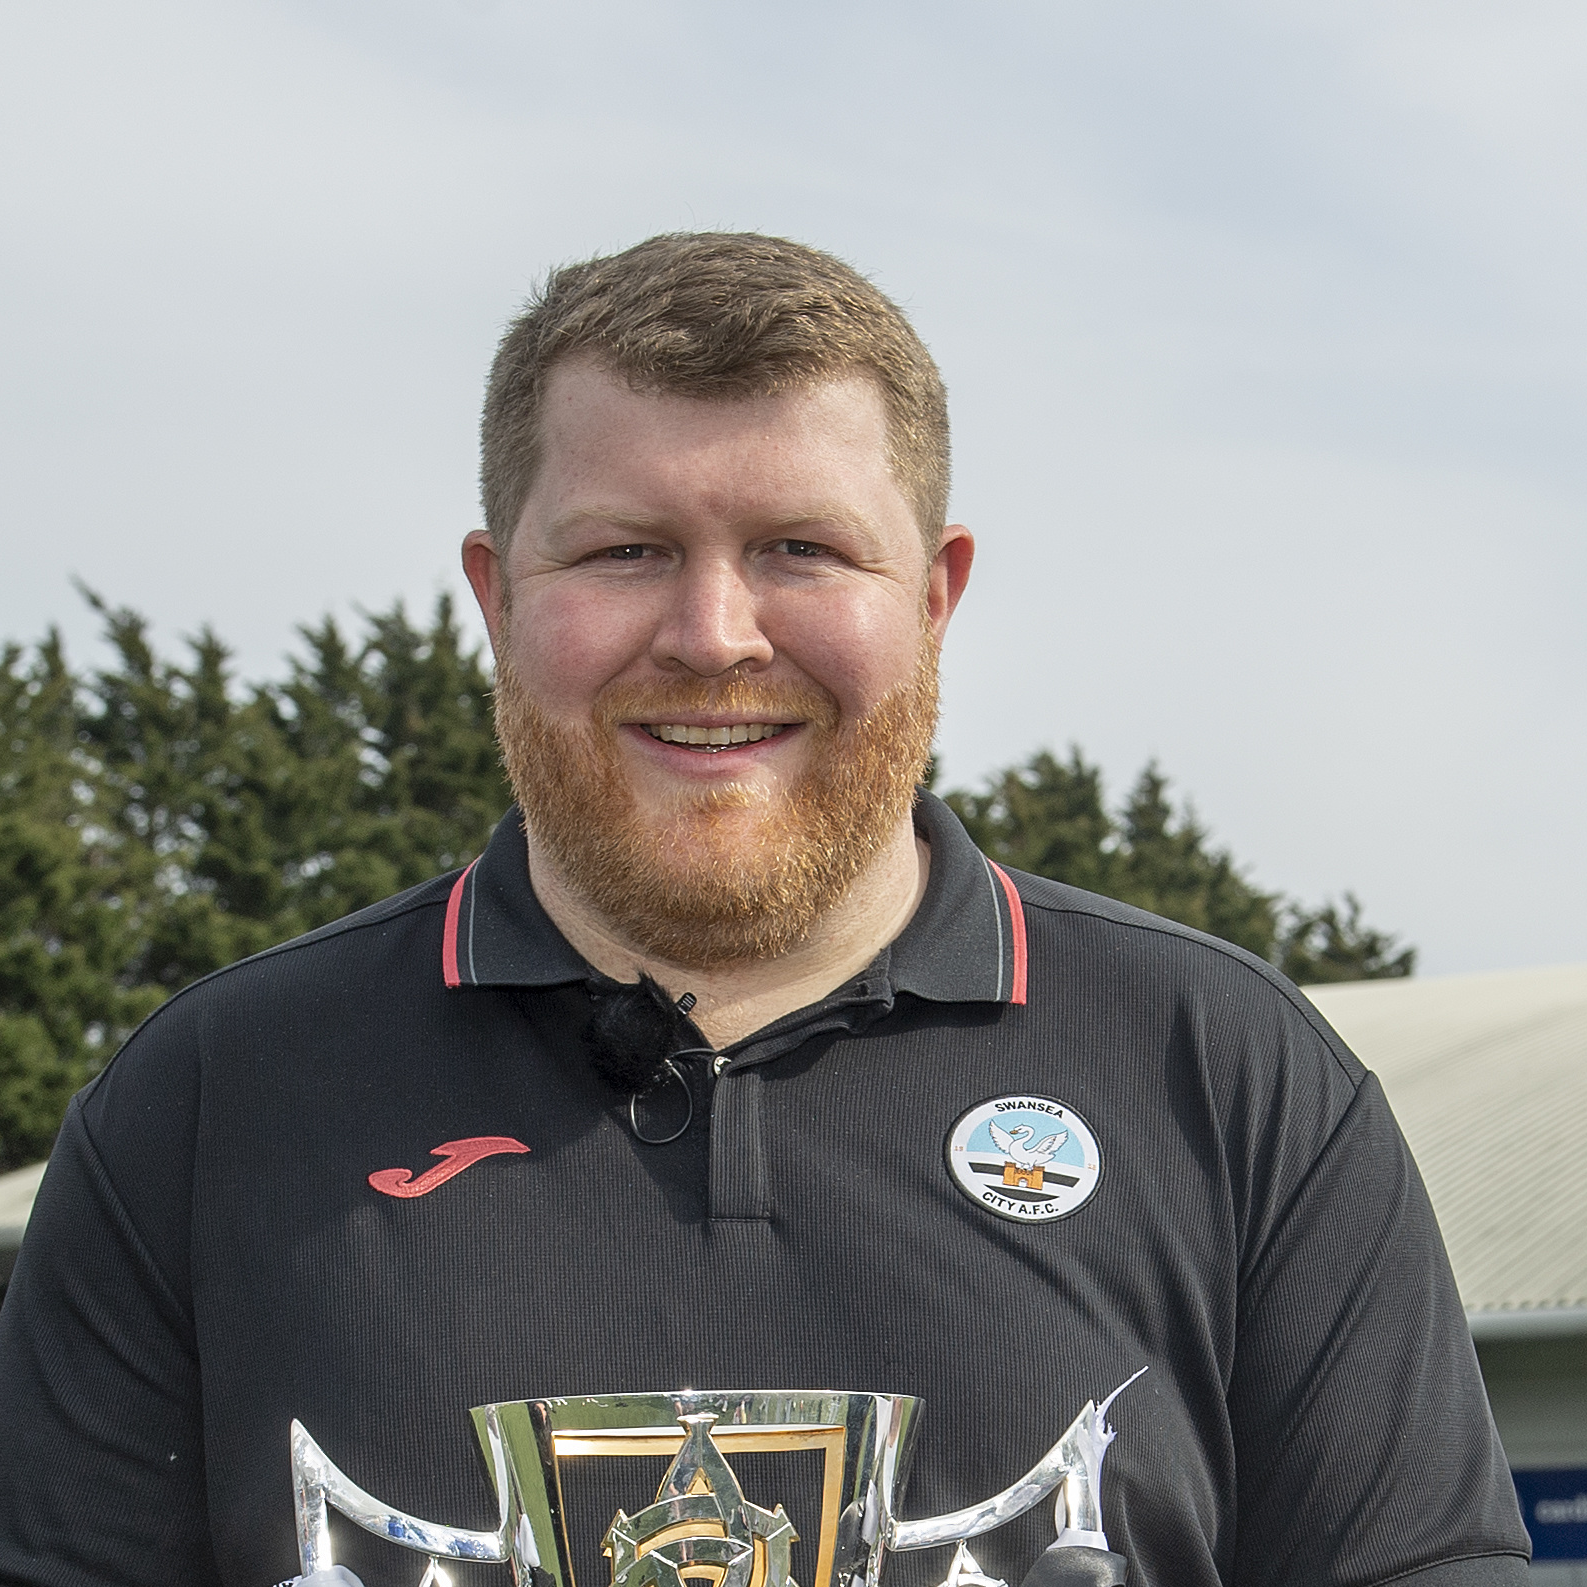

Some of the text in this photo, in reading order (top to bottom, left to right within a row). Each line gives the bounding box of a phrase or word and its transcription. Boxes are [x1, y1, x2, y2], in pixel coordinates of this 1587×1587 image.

[994, 1100, 1064, 1118] SWANSEA
[982, 1191, 1059, 1215] CITY A.F.C.
